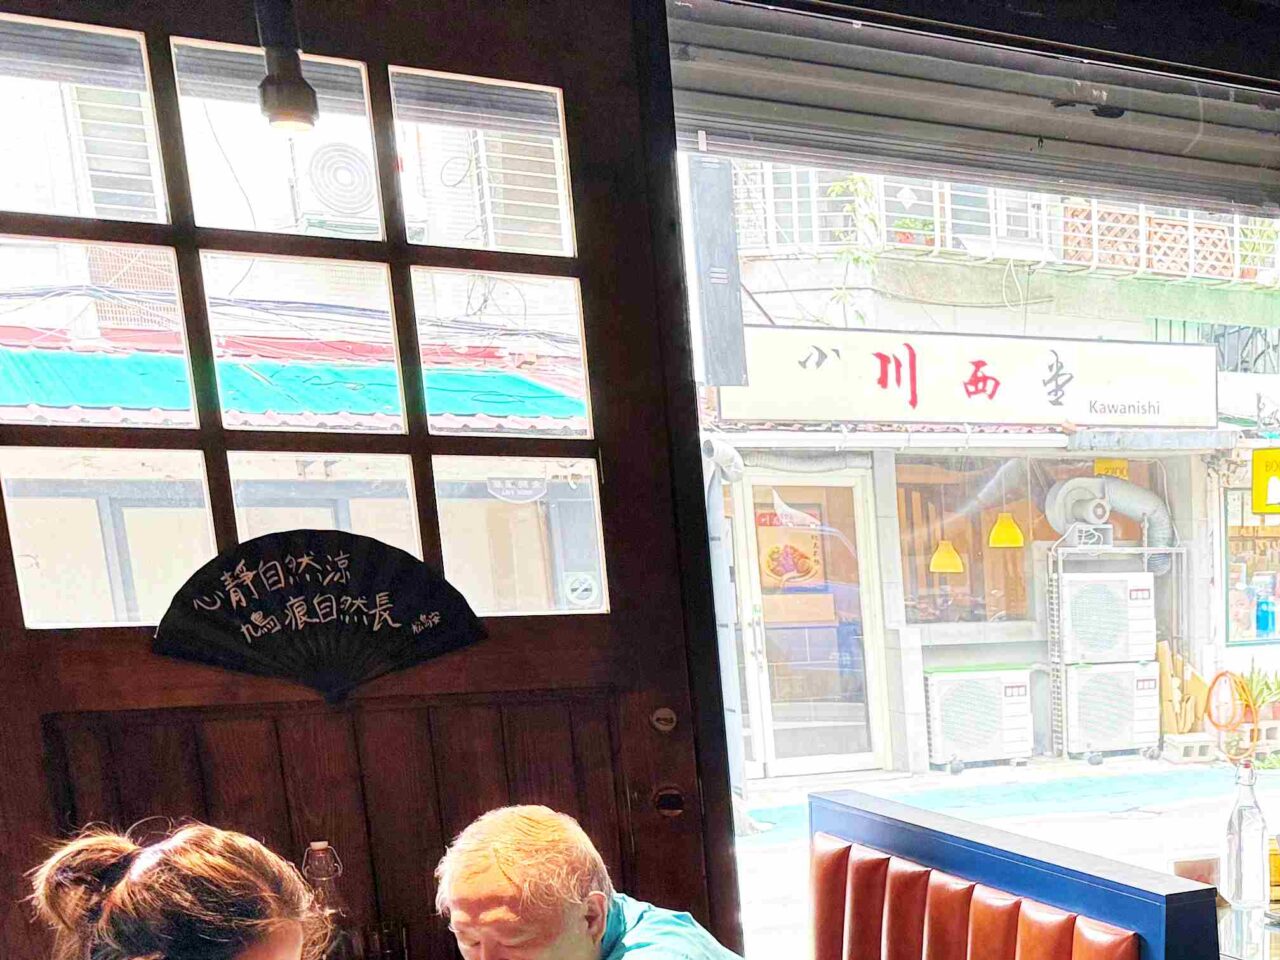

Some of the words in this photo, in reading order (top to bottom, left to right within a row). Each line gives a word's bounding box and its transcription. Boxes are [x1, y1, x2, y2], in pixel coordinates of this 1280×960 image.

[1089, 400, 1161, 416] Kawanishi
[193, 551, 351, 610] 心靜自然涼
